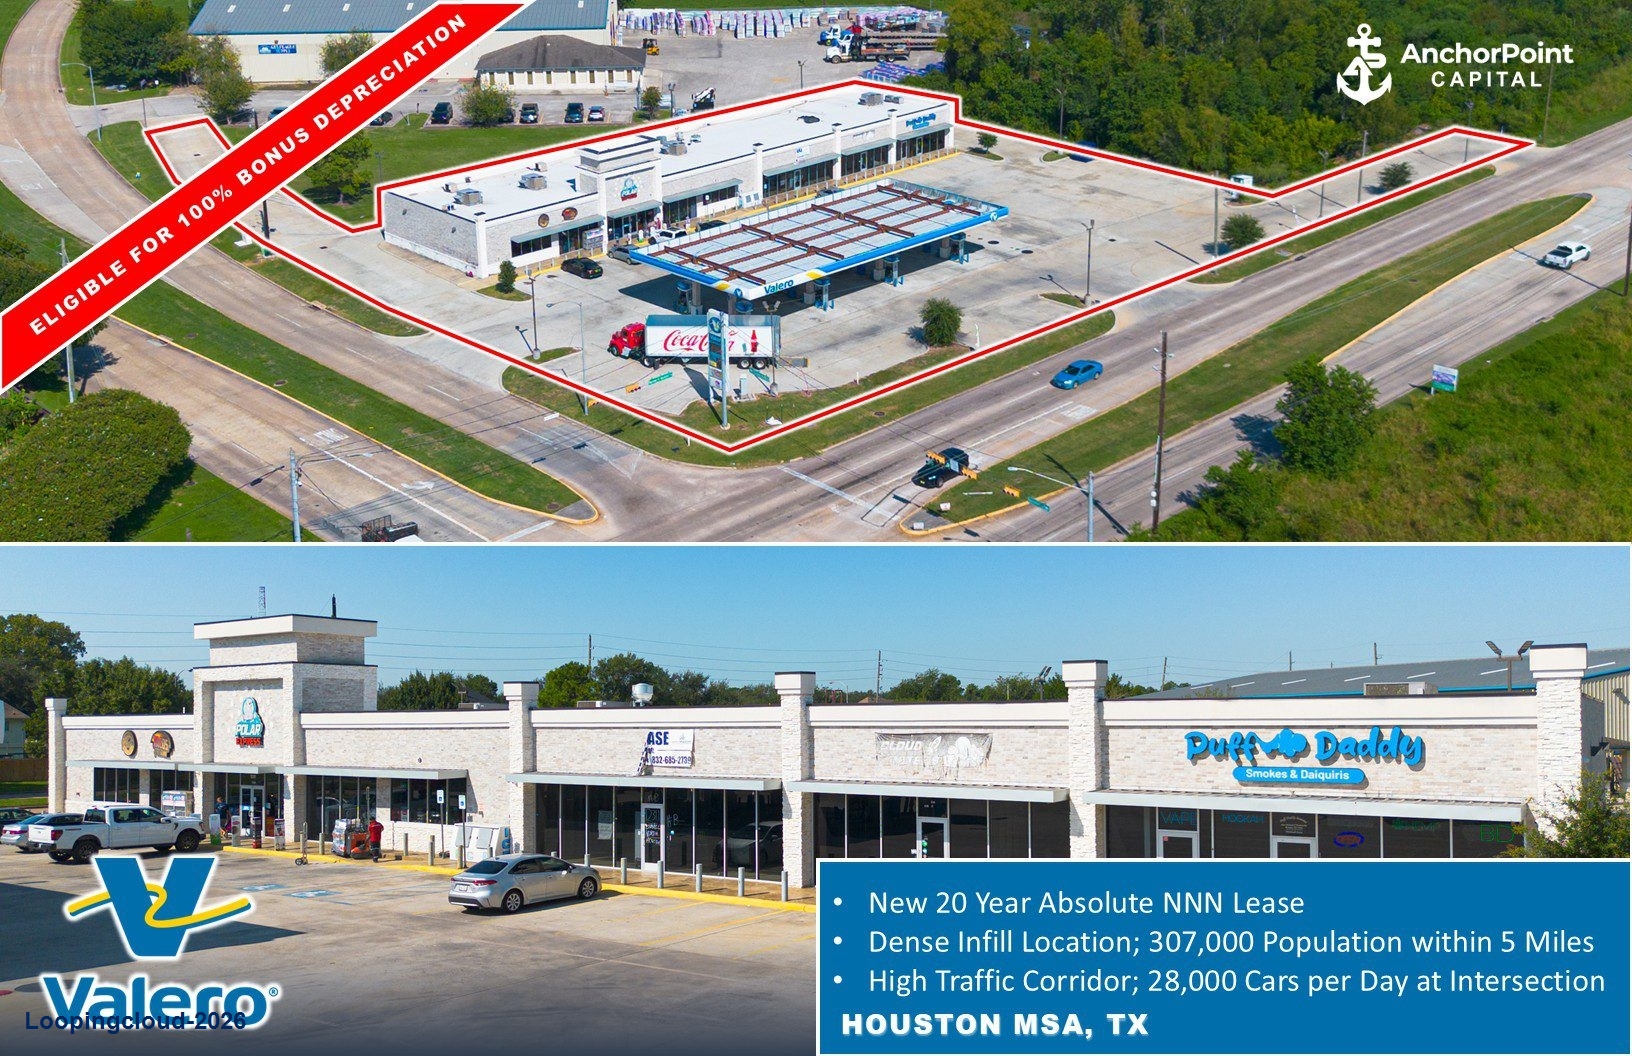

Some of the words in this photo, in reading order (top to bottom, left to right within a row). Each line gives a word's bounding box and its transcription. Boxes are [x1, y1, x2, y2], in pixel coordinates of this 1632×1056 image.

[764, 279, 794, 294] Valero
[236, 723, 262, 736] POLAR
[1184, 731, 1259, 761] Puff
[1314, 726, 1423, 766] Daddy
[1245, 768, 1288, 780] Smokes
[1290, 769, 1299, 780] &
[1301, 769, 1350, 782] Daiquiris
[1160, 811, 1197, 826] VAPE
